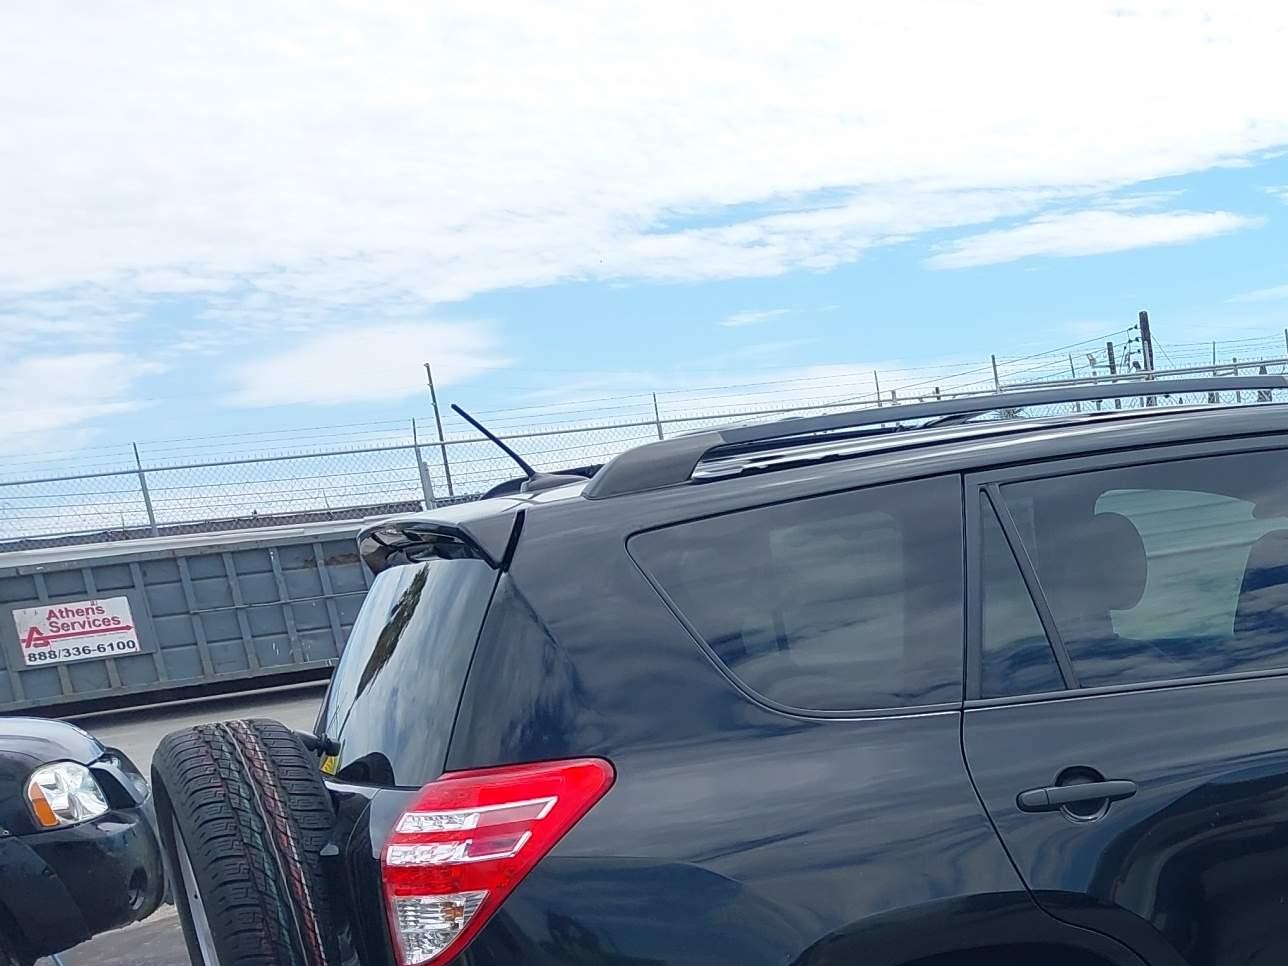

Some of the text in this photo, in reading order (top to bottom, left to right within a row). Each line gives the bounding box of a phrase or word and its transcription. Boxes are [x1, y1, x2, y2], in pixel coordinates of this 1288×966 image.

[46, 605, 105, 621] Athens
[48, 615, 121, 633] Services
[27, 640, 136, 662] 888/336-6100
